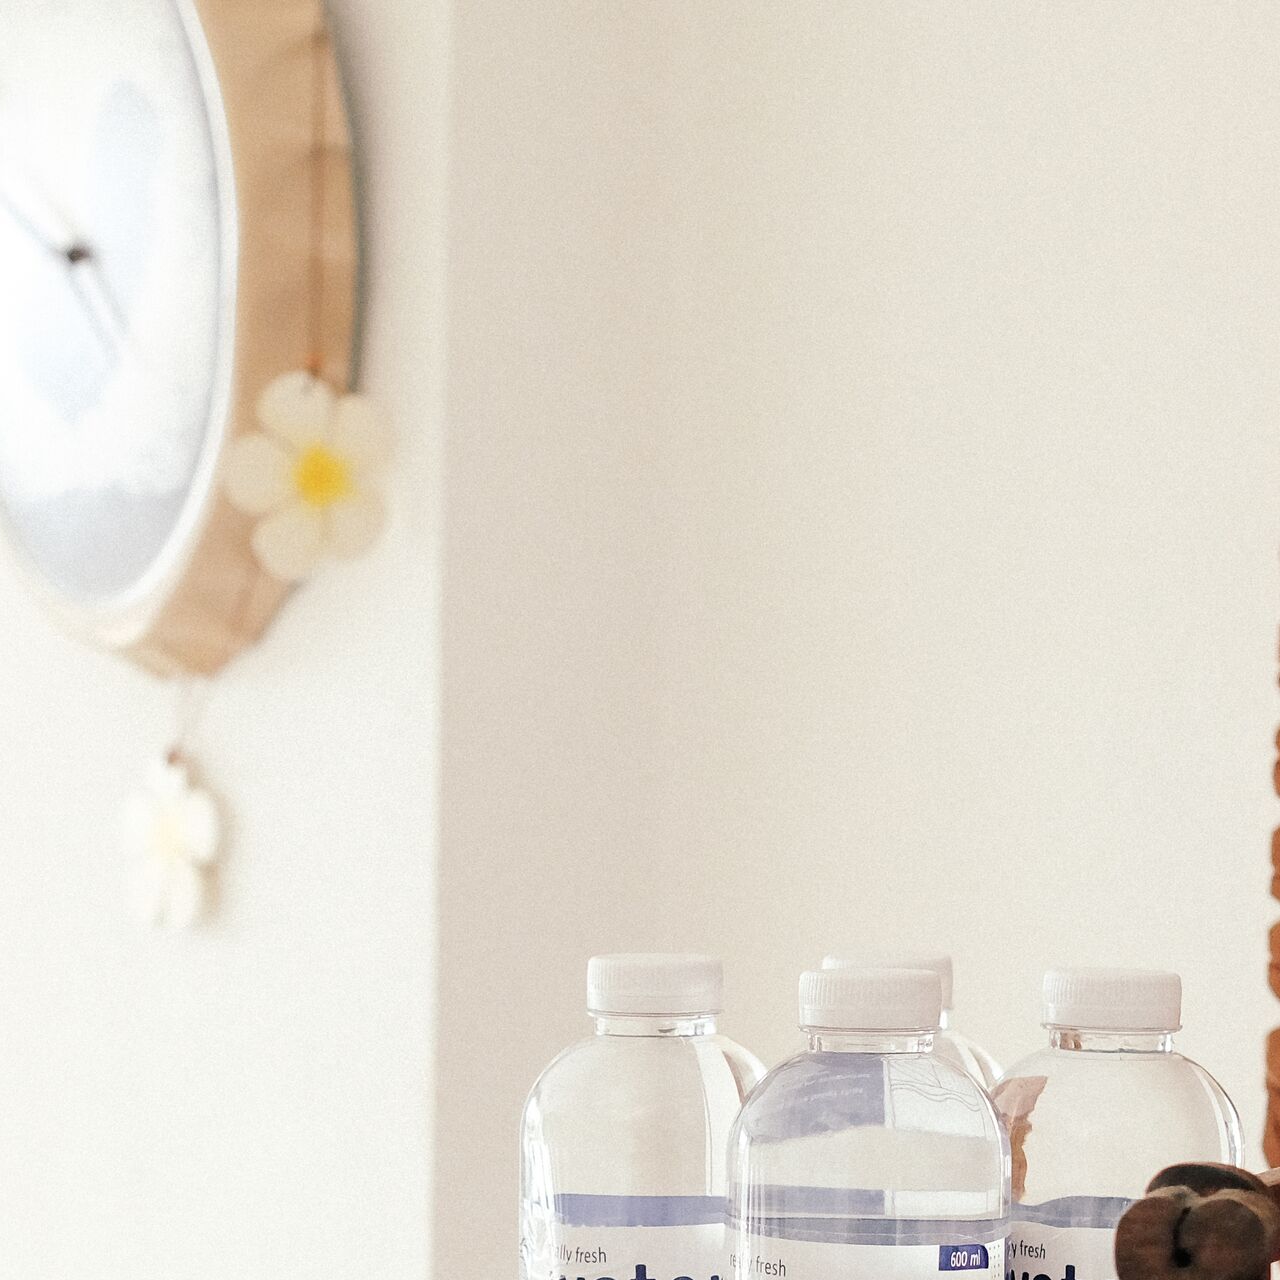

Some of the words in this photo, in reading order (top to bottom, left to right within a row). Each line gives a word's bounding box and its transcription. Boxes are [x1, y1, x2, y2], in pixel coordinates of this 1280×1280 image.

[575, 1246, 607, 1264] fresh
[950, 1251, 968, 1268] 600
[970, 1249, 981, 1267] ml
[1020, 1240, 1047, 1260] fresh
[755, 1255, 787, 1278] fresh
